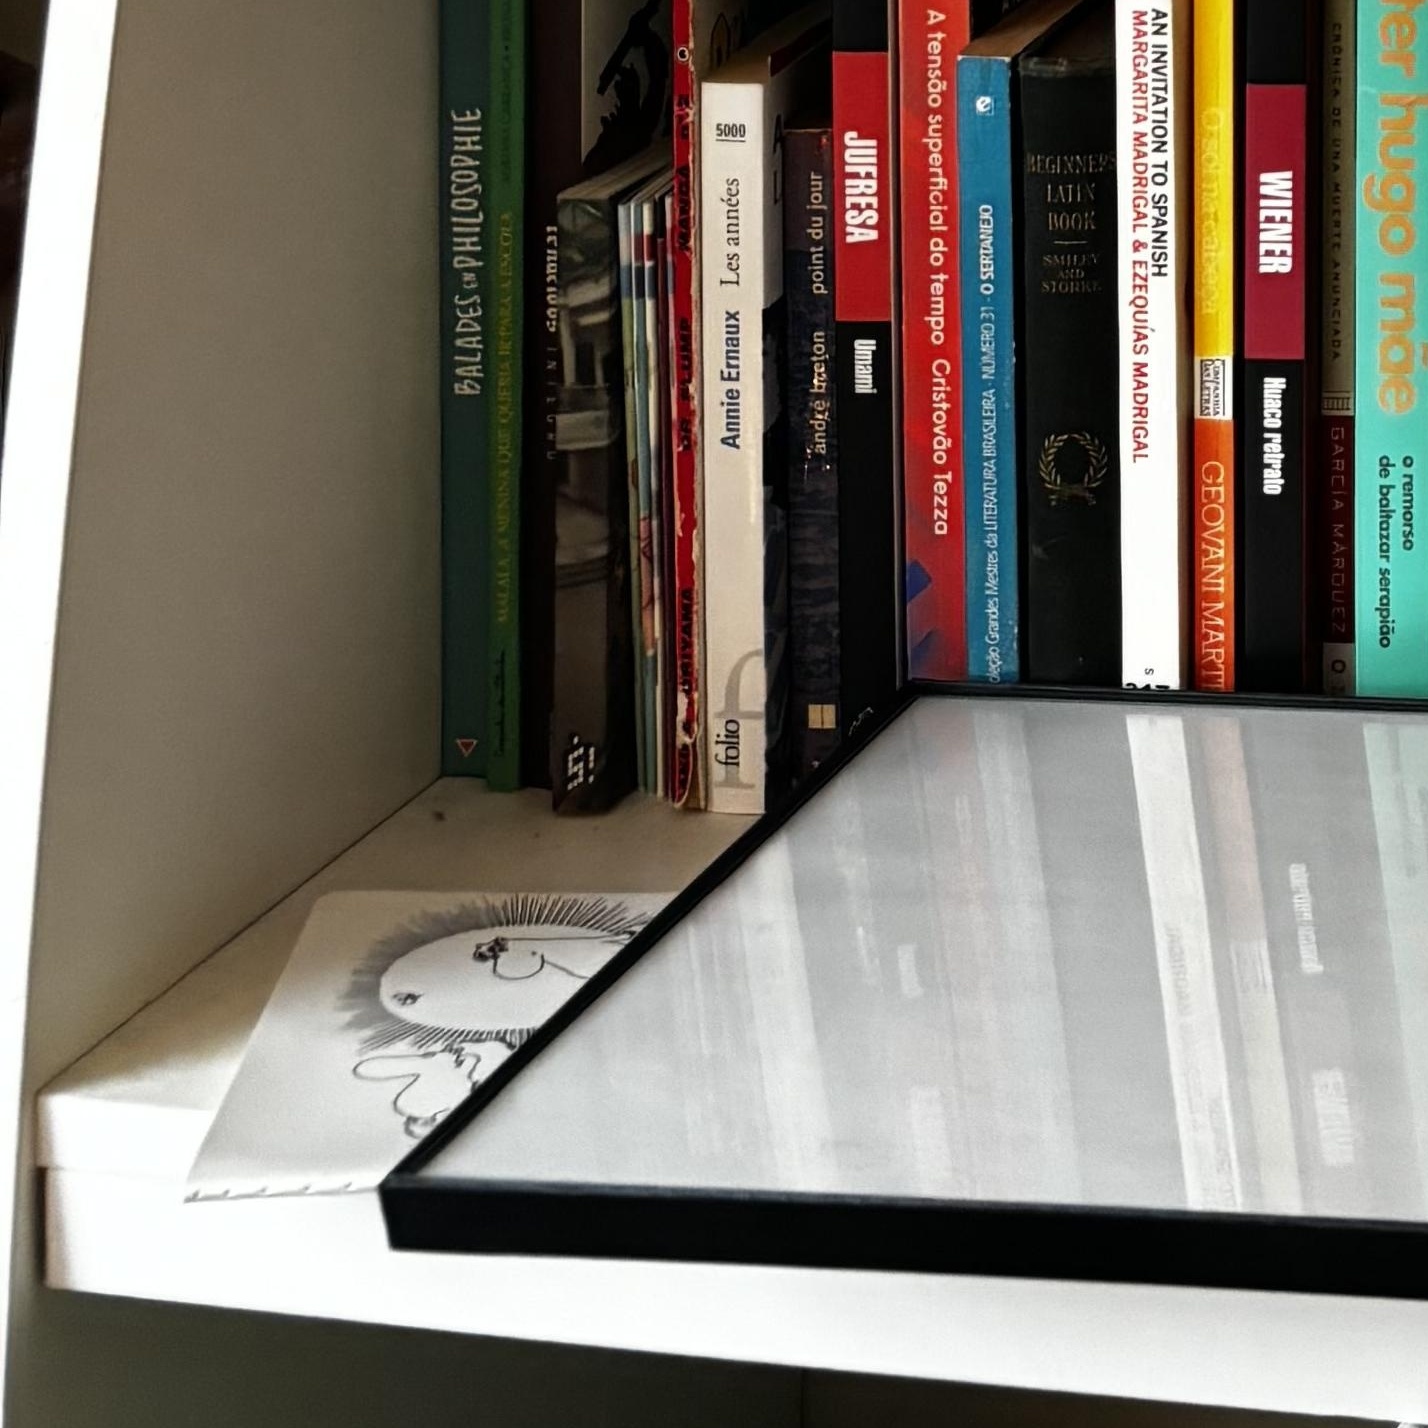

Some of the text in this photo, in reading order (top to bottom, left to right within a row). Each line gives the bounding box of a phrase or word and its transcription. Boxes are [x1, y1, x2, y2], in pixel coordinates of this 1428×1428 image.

[449, 108, 484, 269] PHILOSOPHIE
[1132, 10, 1151, 464] MARGARITA MADRIGAL MADRIGAL
[1151, 43, 1170, 277] INVITATION SPANISH
[1257, 170, 1294, 274] WIENER
[452, 295, 484, 395] BALADES
[807, 245, 831, 295] point
[844, 131, 881, 394] JUFRESA Umami
[921, 31, 955, 535] tensão superficial tempo Cristovão Tezza
[977, 203, 999, 531] LITERATURA BRASILEIRA SERTANEJO
[713, 178, 742, 768] folio Annie Ernaux Les années
[1200, 460, 1225, 591] GEOVANI
[1378, 487, 1397, 566] baltazar
